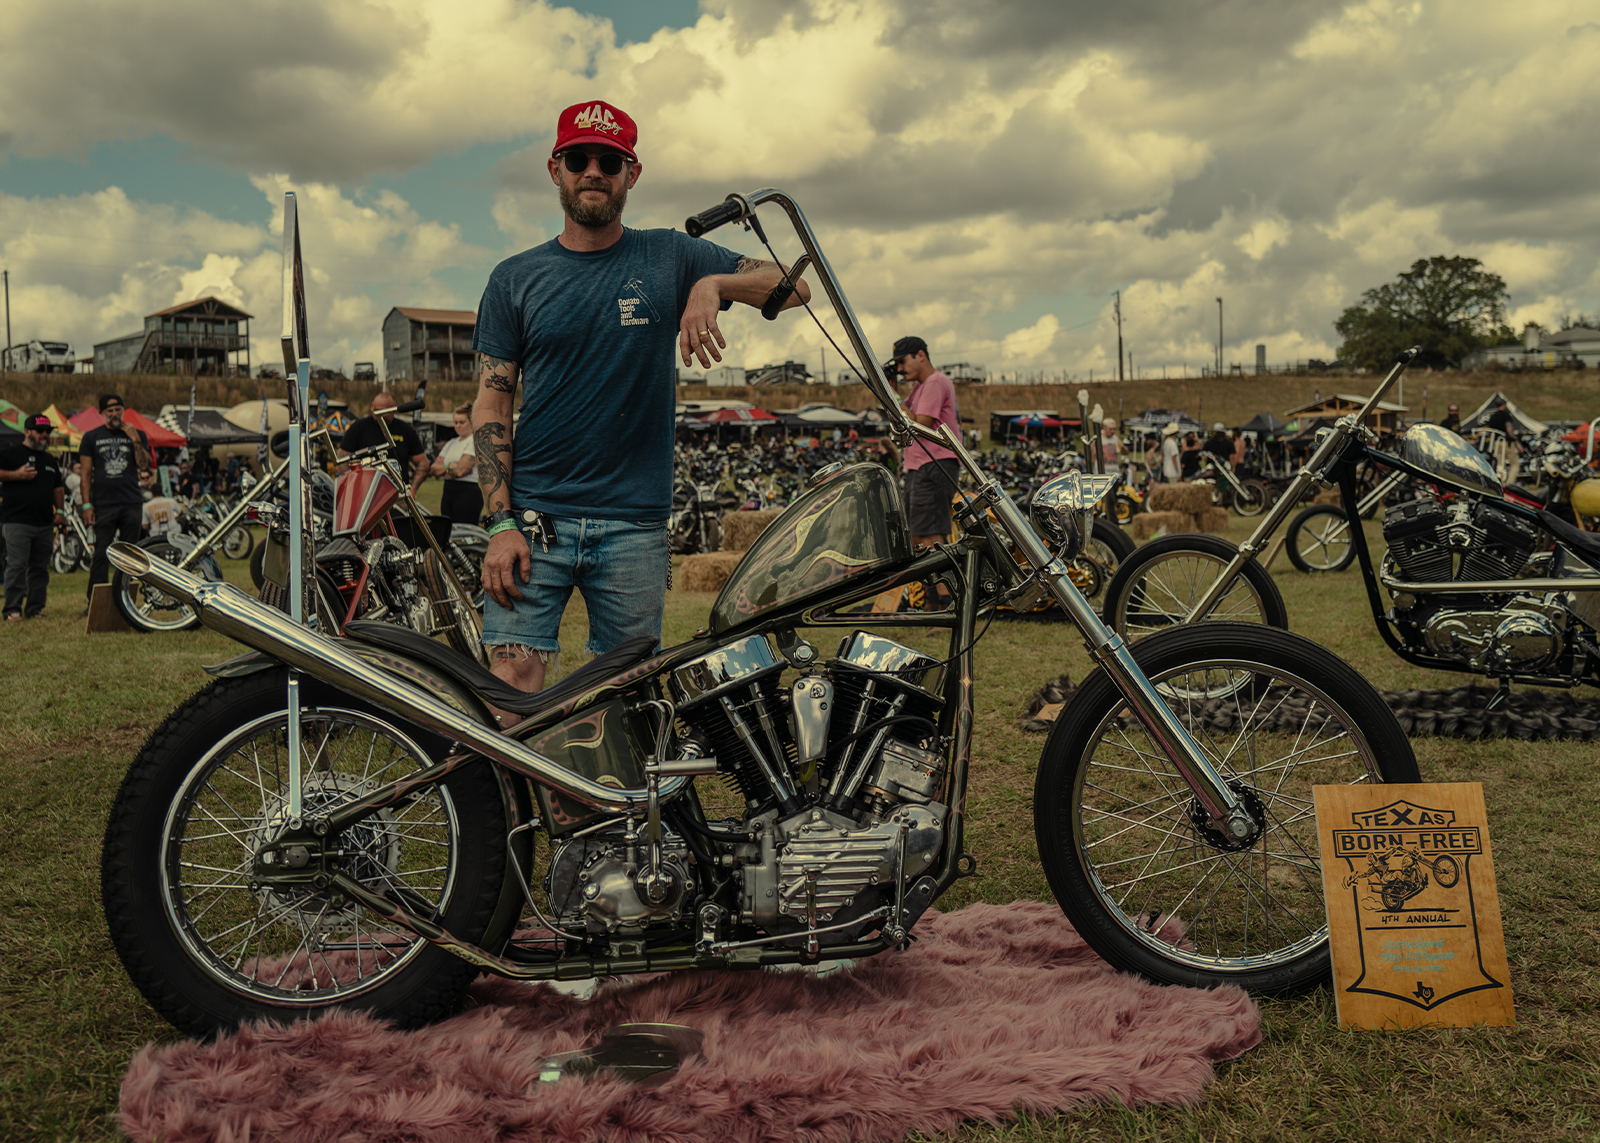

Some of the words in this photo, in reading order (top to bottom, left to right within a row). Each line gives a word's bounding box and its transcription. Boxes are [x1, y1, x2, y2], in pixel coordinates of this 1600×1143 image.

[573, 104, 615, 126] MAC
[618, 298, 640, 306] Donato
[619, 305, 635, 313] Tools
[620, 311, 633, 319] and
[620, 317, 650, 327] Hardware
[1361, 807, 1446, 827] TEXAS
[1341, 832, 1476, 851] BORN-FREE
[1083, 897, 1113, 932] AVON
[1381, 915, 1400, 925] 4TH
[1405, 913, 1451, 924] ANNUAL
[1380, 952, 1403, 962] 1950
[1405, 951, 1421, 962] H-D
